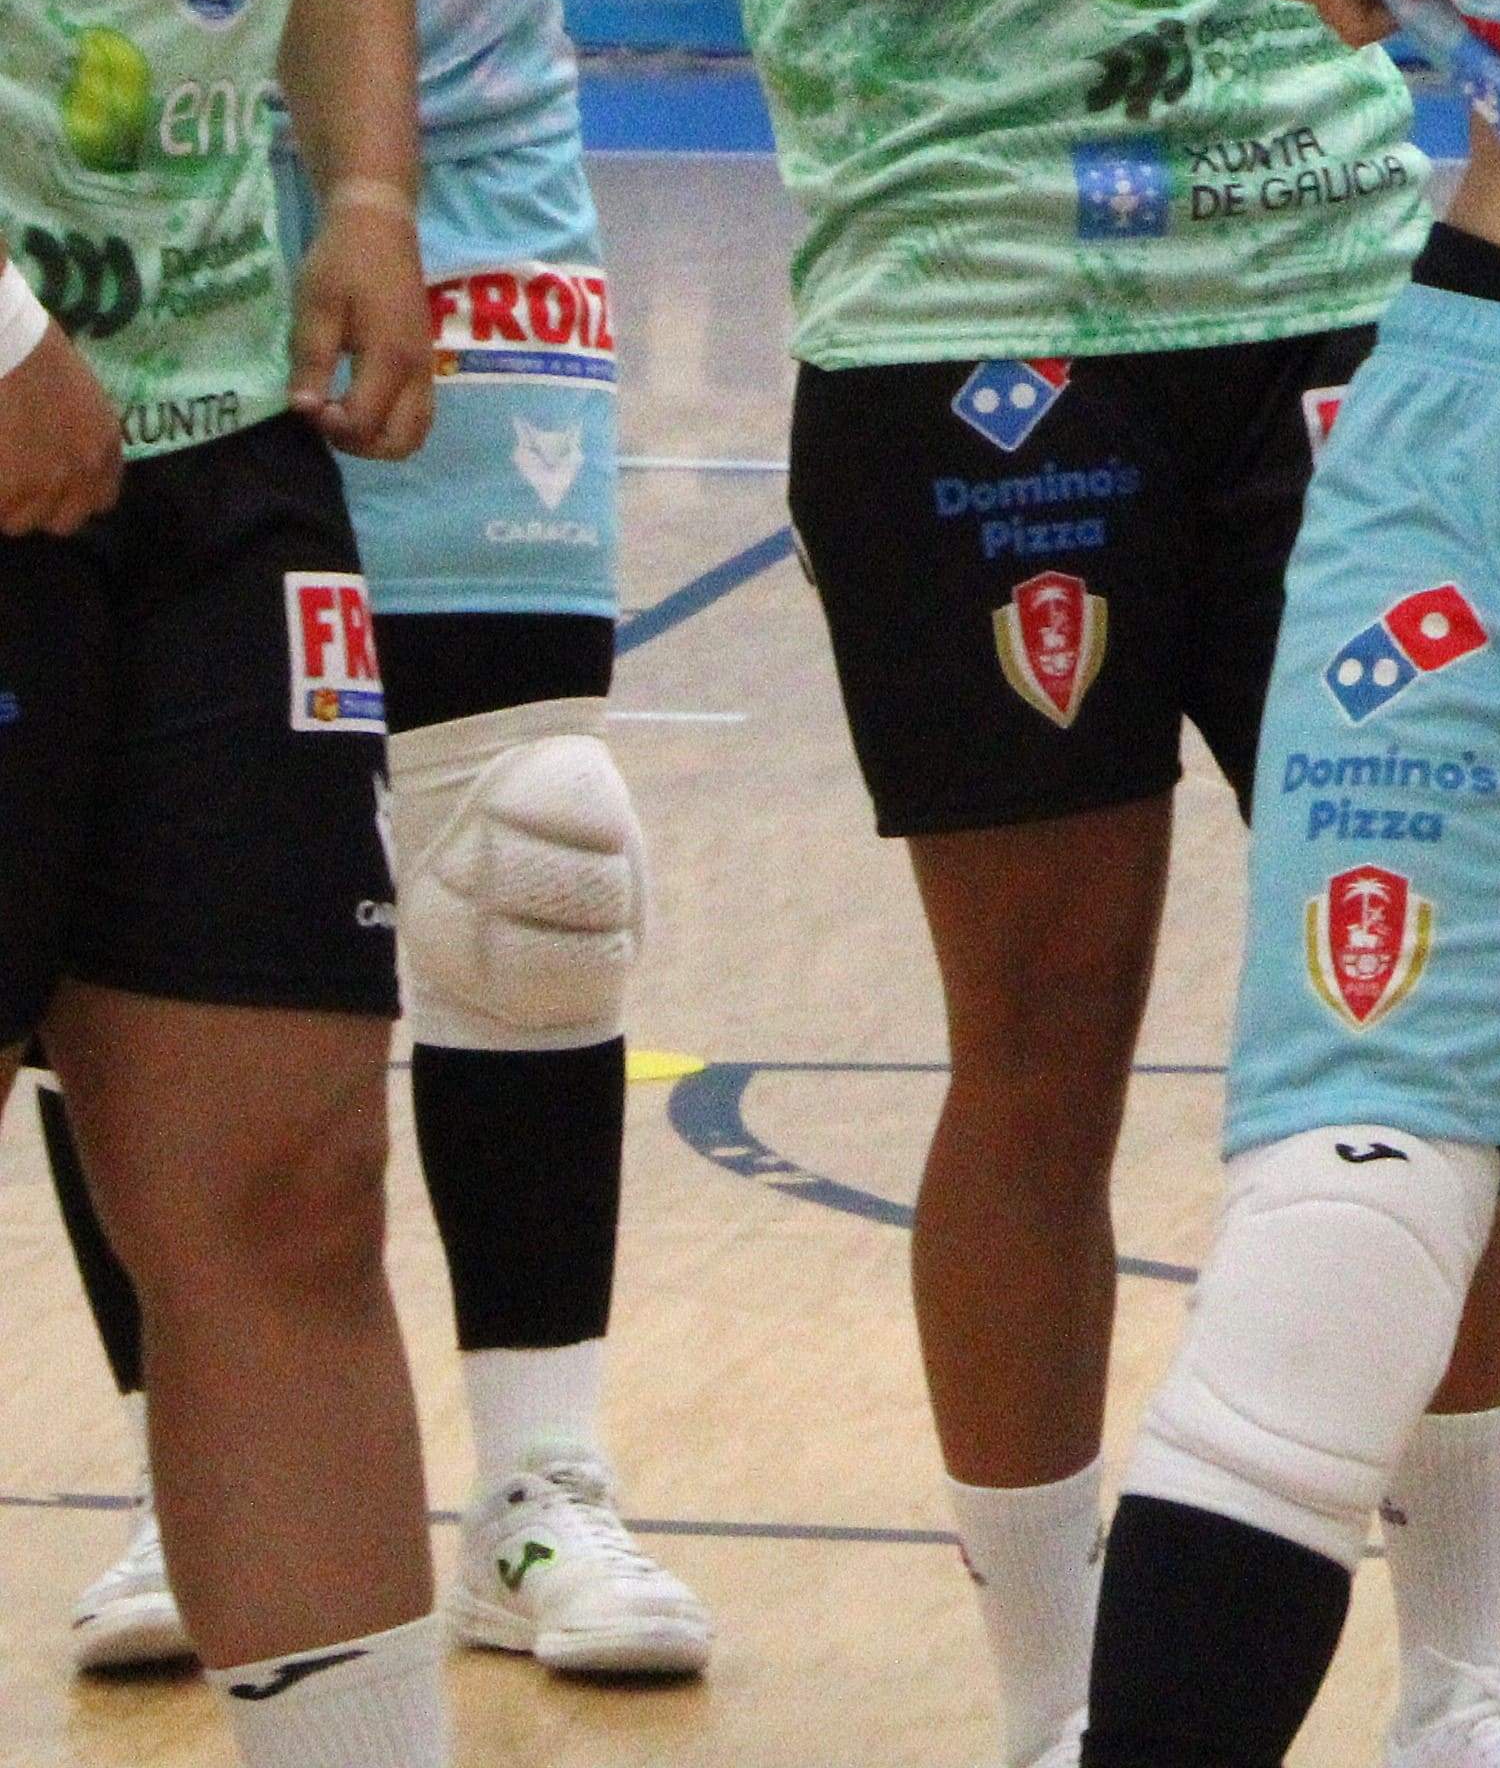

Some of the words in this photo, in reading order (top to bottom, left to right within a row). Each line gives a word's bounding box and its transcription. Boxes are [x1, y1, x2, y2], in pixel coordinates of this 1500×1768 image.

[1186, 128, 1325, 174] XUNTA
[1192, 182, 1248, 220] DE
[1260, 155, 1408, 211] GALICIA
[982, 516, 1107, 559] Pizza
[1282, 747, 1499, 798] Domino's
[1305, 799, 1443, 843] Pizza
